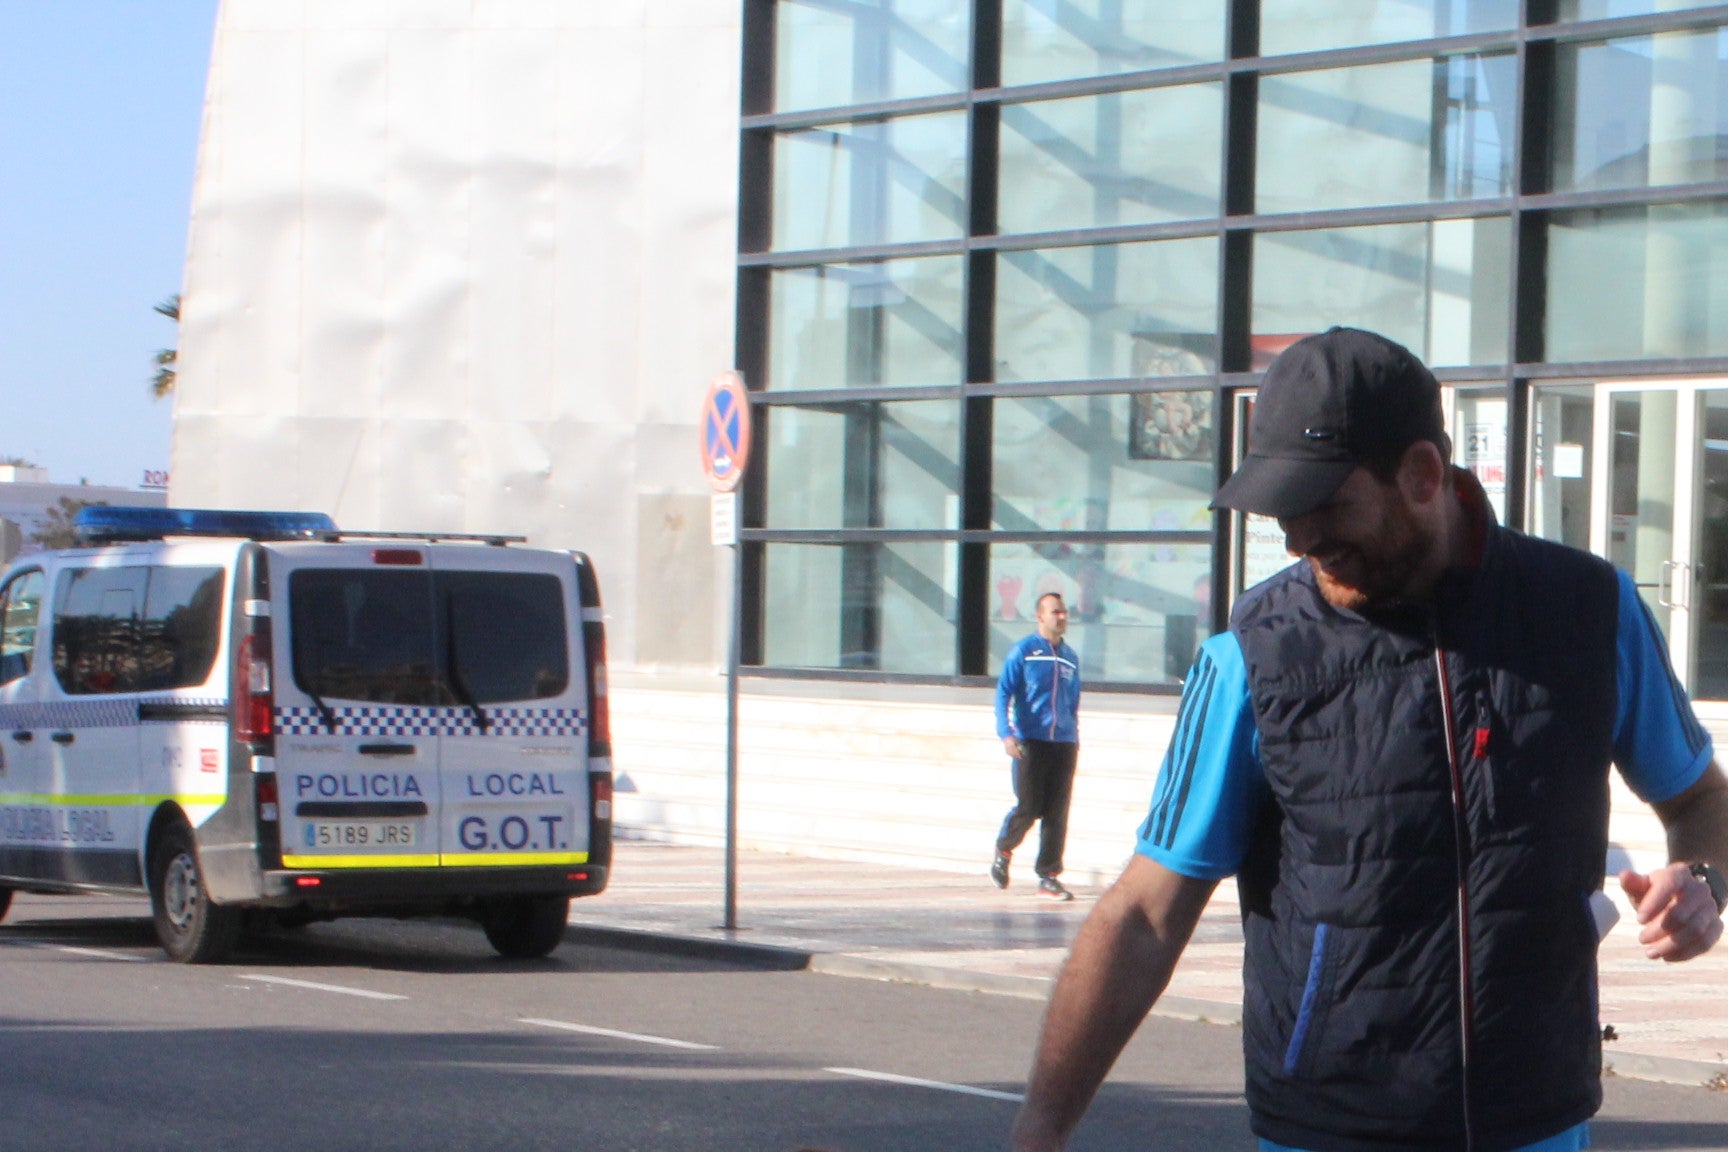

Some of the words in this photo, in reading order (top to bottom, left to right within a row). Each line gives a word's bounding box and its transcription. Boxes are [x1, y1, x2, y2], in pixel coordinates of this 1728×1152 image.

[296, 773, 423, 798] POLICIA
[466, 773, 565, 797] LOCAL
[319, 825, 369, 845] 5189
[376, 825, 412, 845] JRS
[458, 815, 568, 851] G.O.T.
